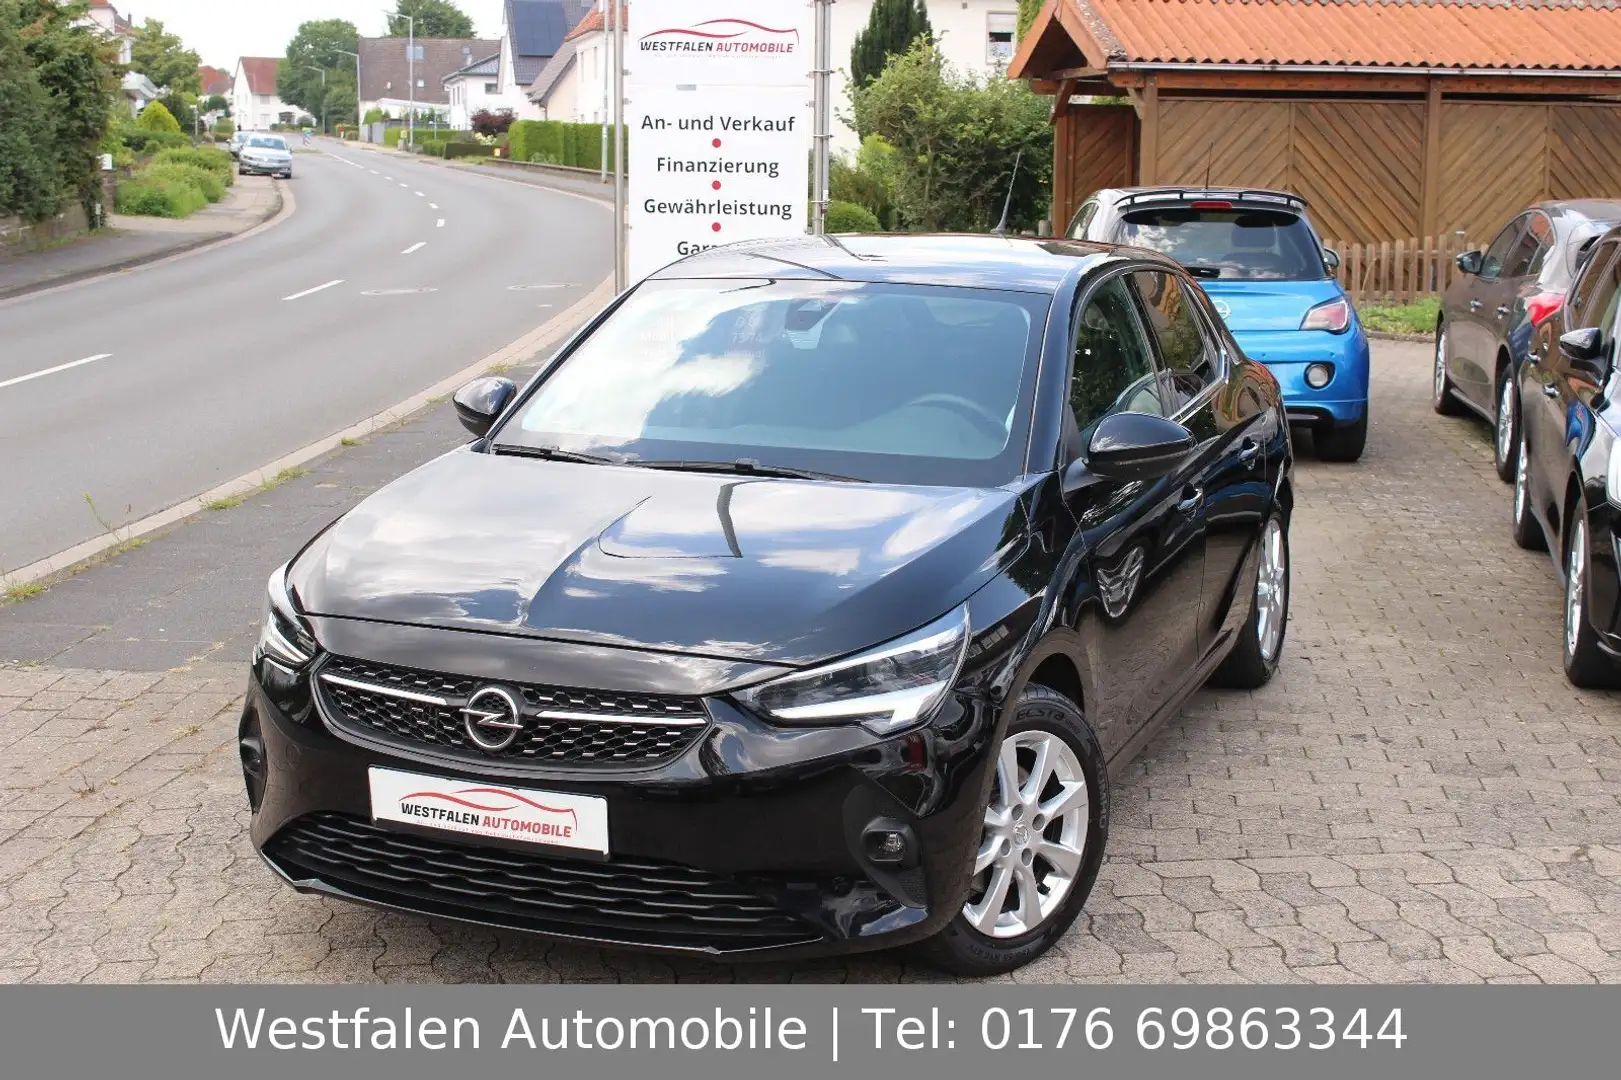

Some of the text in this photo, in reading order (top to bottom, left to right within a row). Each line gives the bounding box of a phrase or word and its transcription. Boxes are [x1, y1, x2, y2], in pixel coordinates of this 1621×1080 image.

[640, 41, 794, 53] WESTFALEN AUTOMOBILE
[641, 115, 796, 132] An- und Verkauf
[657, 157, 780, 178] Finanzierung
[643, 198, 792, 220] Gewährleistung
[677, 240, 718, 255] Gar
[401, 802, 479, 826] WESTFALEN
[482, 815, 573, 838] AUTOMOBILE
